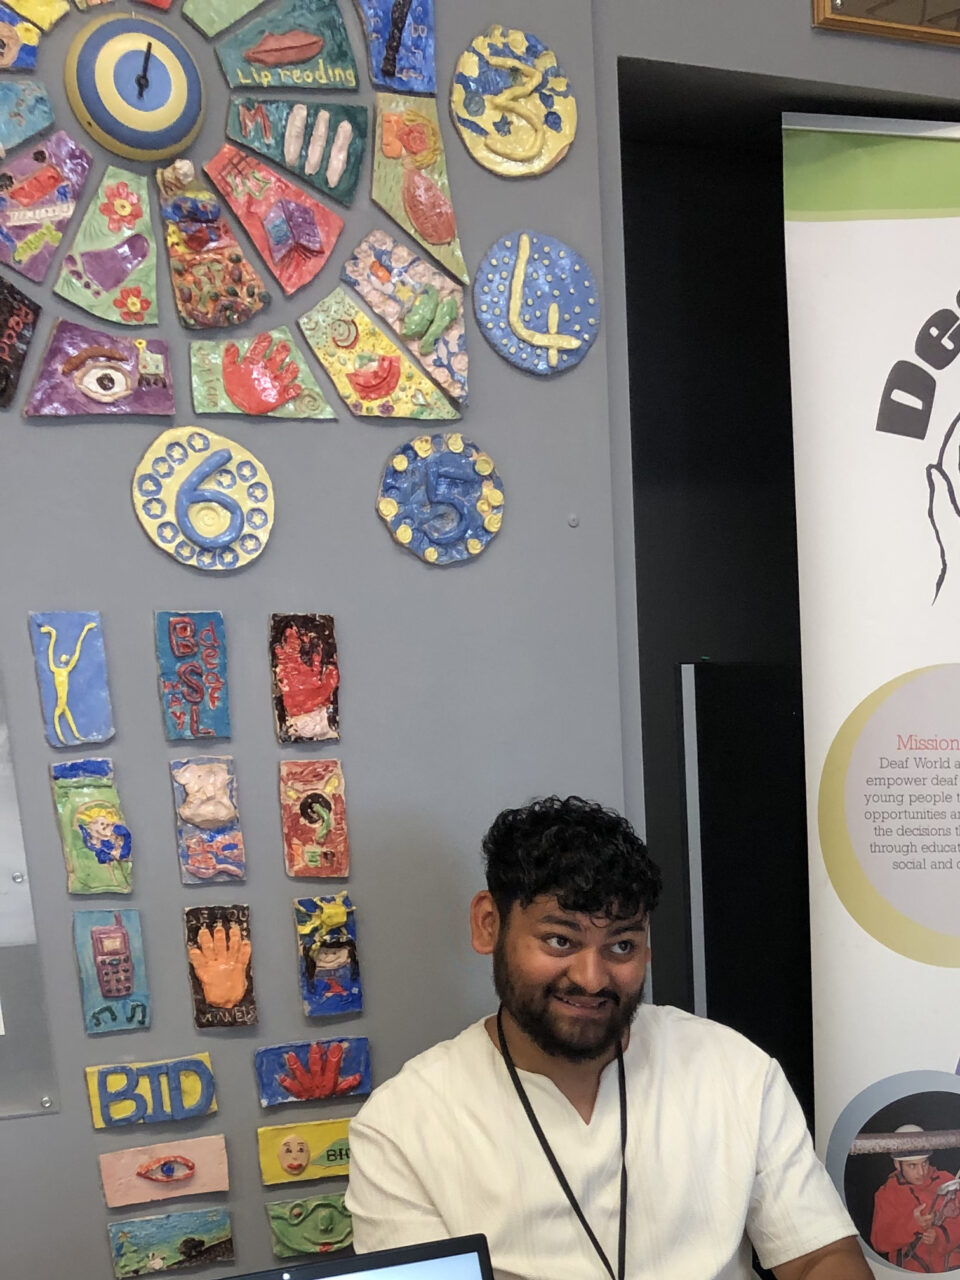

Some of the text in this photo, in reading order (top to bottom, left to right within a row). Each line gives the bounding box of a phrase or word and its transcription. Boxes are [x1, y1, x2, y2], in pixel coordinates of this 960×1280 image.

[238, 69, 272, 87] Lip
[508, 233, 582, 368] 4
[176, 448, 245, 547] 6
[897, 734, 960, 751] Mission
[879, 756, 909, 769] Deaf
[914, 757, 951, 769] World
[866, 777, 927, 789] empower
[931, 774, 958, 786] deaf
[864, 793, 904, 806] young
[909, 792, 951, 806] people
[864, 809, 946, 823] opportunities
[874, 825, 893, 837] the
[896, 825, 951, 837] decisions
[870, 842, 918, 856] through
[892, 859, 926, 870] social
[930, 859, 953, 870] and
[99, 1058, 216, 1128] BID
